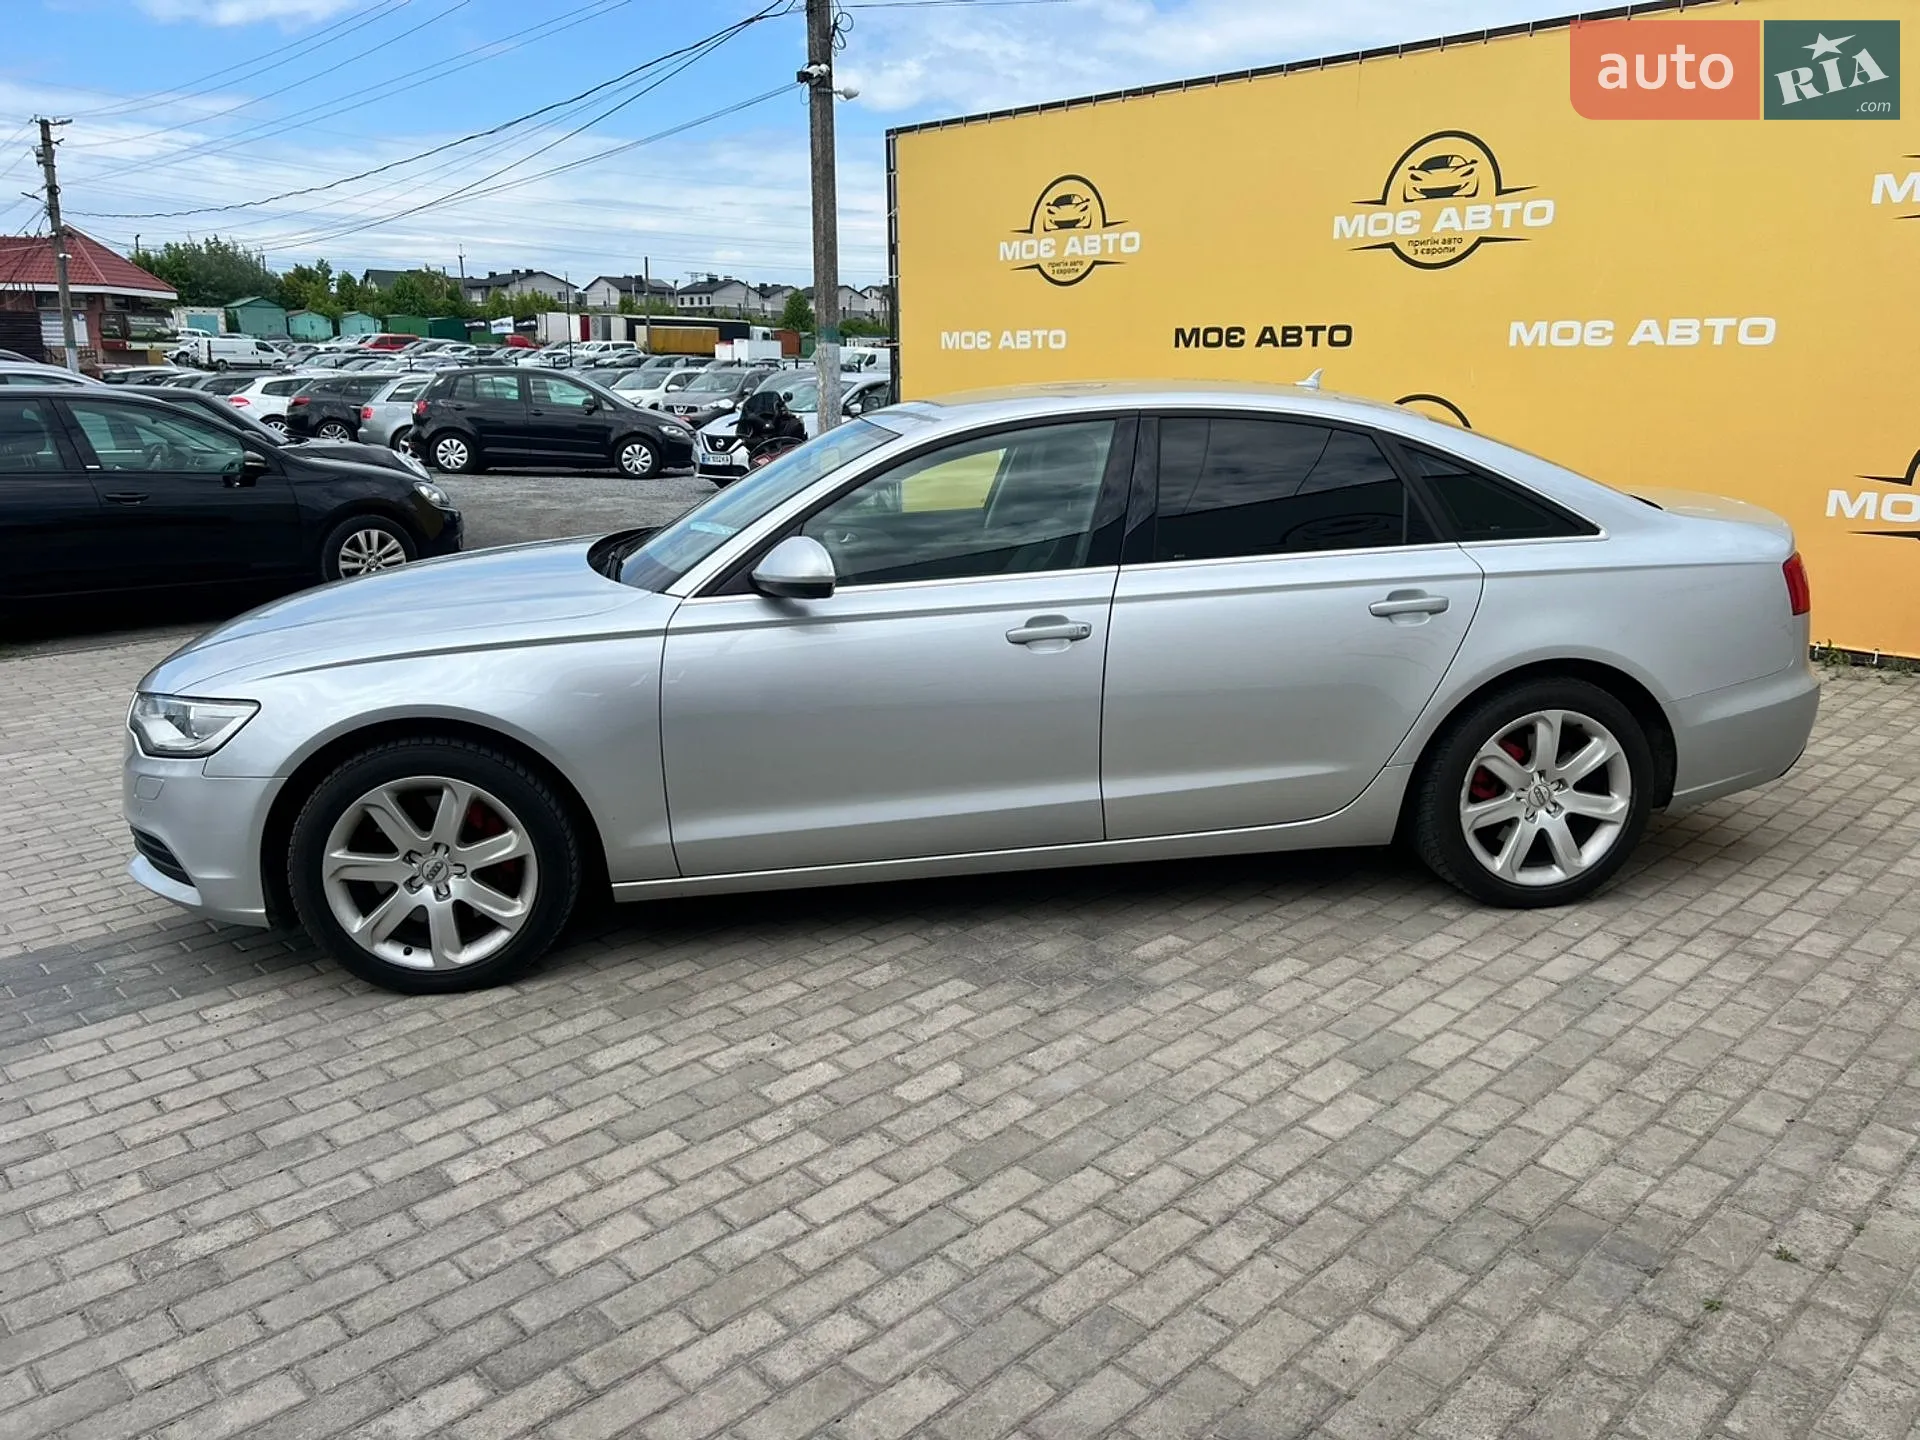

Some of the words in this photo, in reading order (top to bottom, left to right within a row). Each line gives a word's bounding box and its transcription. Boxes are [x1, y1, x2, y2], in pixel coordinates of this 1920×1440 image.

[1332, 209, 1422, 240] МОЄ
[1432, 199, 1555, 233] АВТО
[999, 237, 1057, 261] МОЄ
[1063, 231, 1141, 257] АВТО
[940, 331, 992, 350] МОЄ
[998, 329, 1067, 350] АВТО
[1173, 326, 1246, 349] МОЄ
[1254, 324, 1353, 348] АВТО
[1508, 319, 1614, 347] МОЄ
[1627, 316, 1776, 346] АВТО
